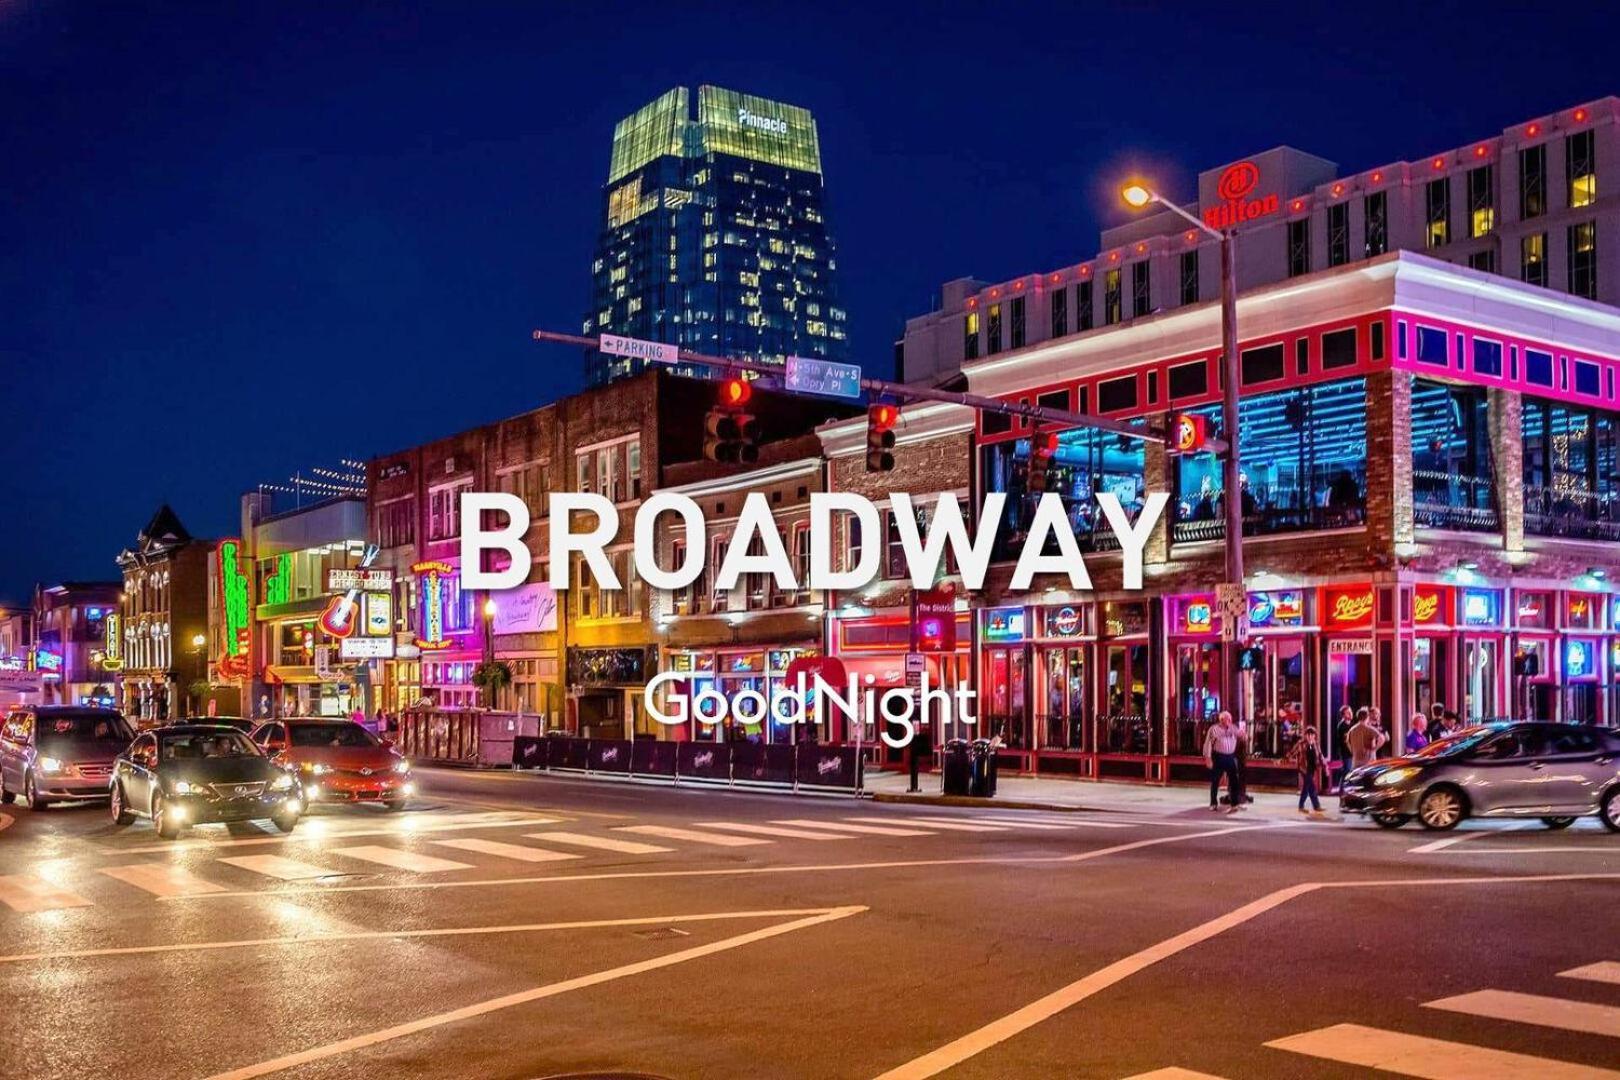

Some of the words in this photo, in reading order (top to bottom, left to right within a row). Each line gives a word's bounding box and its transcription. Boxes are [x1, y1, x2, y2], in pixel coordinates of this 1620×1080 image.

[738, 108, 787, 134] Pinnacle
[1204, 193, 1279, 230] Hilton
[616, 339, 664, 358] PARKING
[802, 376, 826, 391] Opry
[918, 603, 932, 613] The
